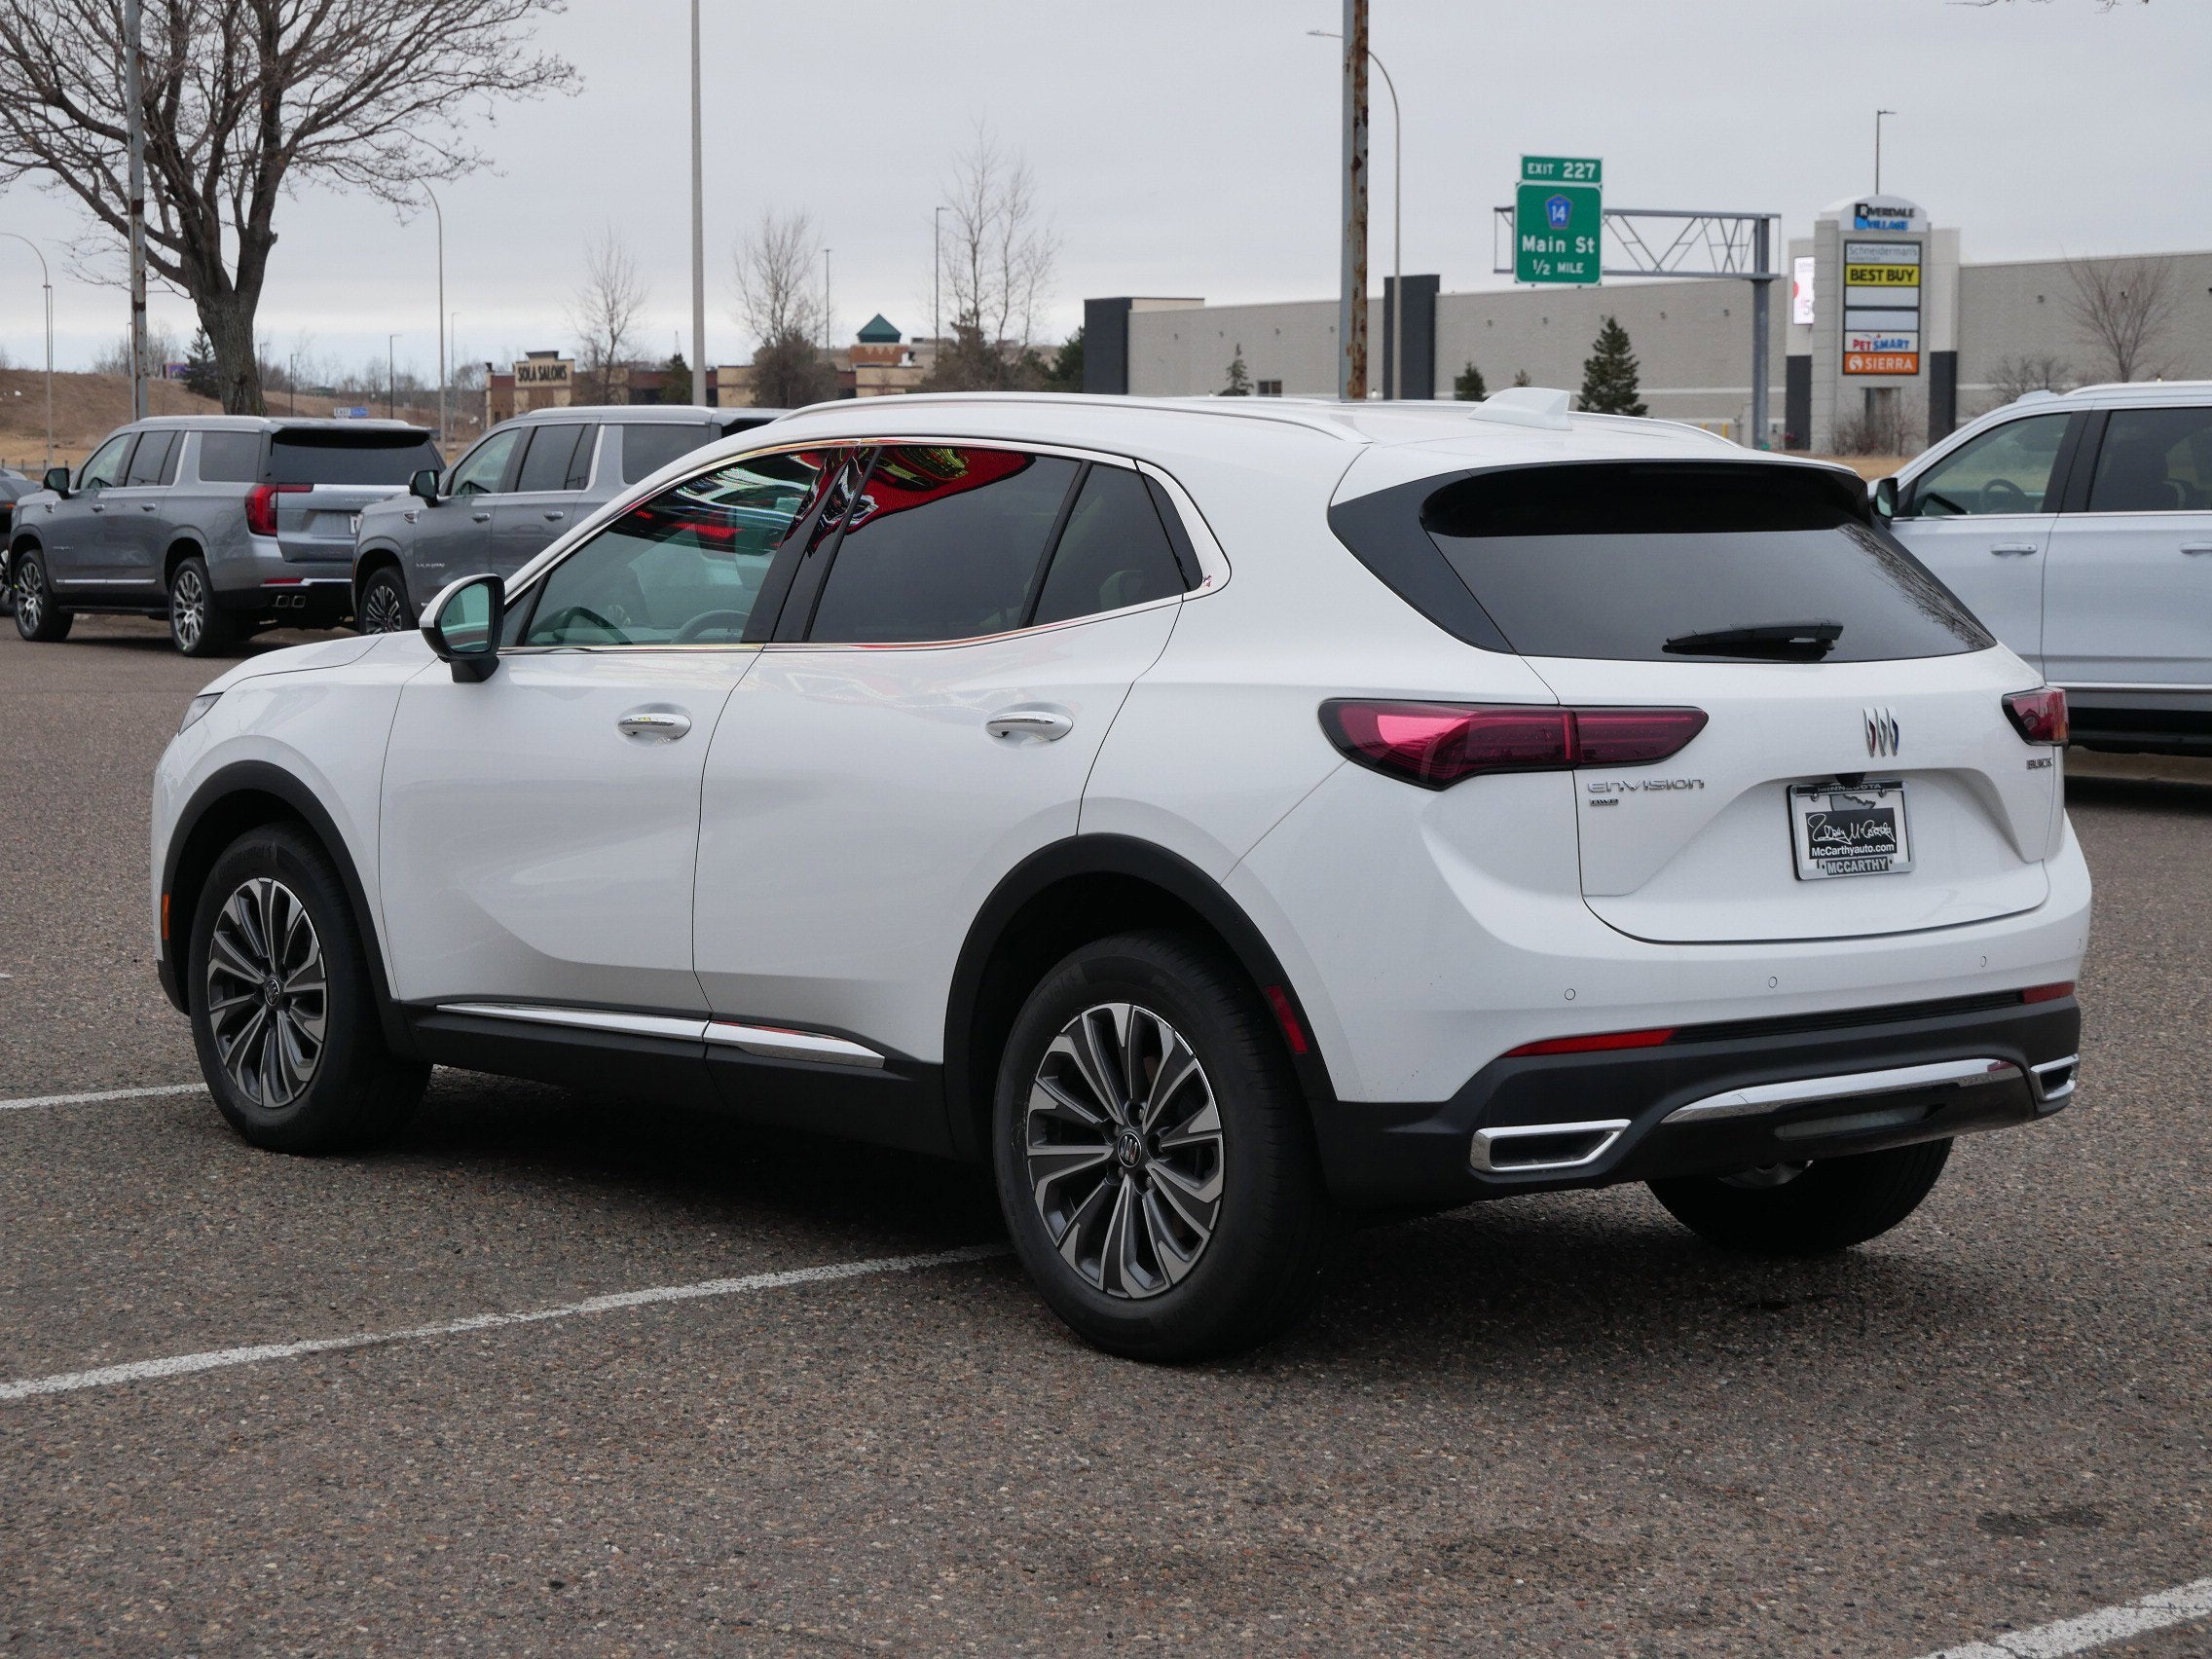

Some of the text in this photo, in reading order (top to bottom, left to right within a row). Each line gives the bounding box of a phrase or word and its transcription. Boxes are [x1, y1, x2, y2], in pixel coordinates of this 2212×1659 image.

[1527, 162, 1597, 179] EXIT 227
[1552, 204, 1567, 222] 14
[1522, 235, 1596, 253] Main St
[1557, 262, 1584, 274] MILE
[1850, 269, 1915, 282] BEST BUY
[1864, 356, 1913, 370] SIERRA
[518, 364, 567, 382] SOLA SALONS
[1811, 843, 1895, 857] McCarthyauto.com
[1826, 858, 1888, 874] MCCARTHY
